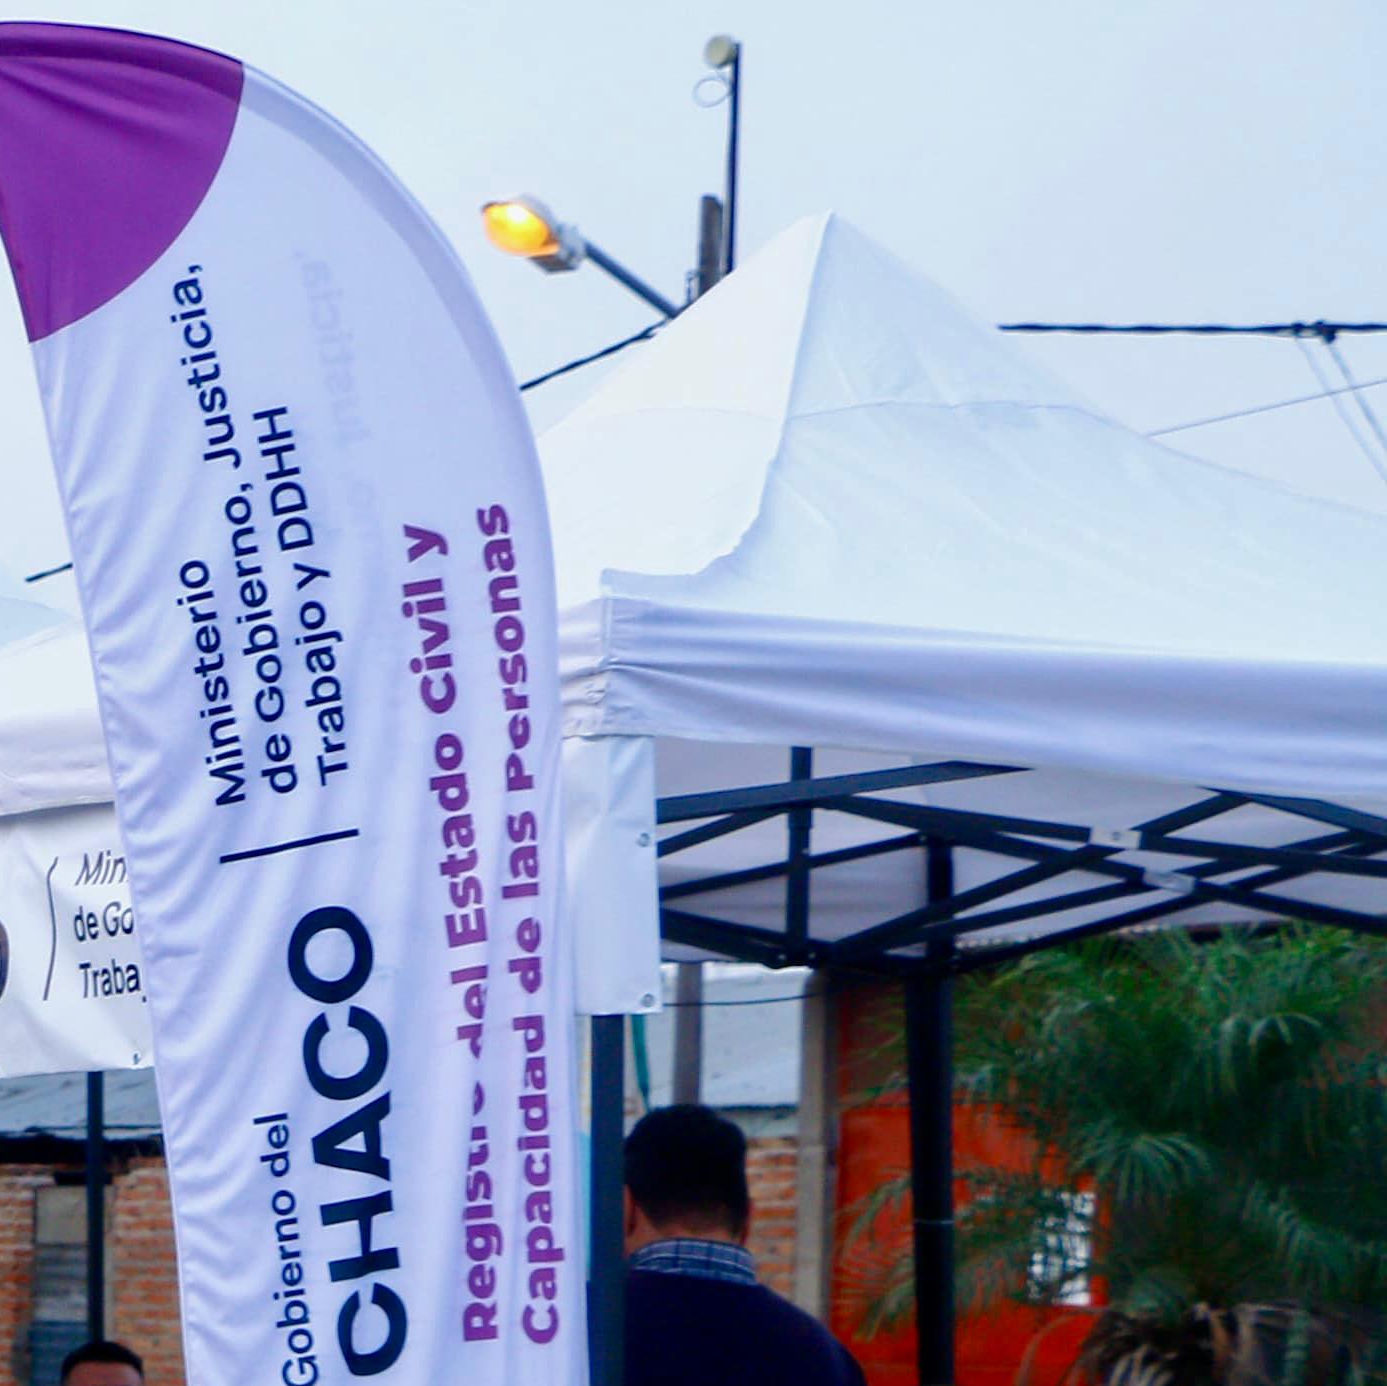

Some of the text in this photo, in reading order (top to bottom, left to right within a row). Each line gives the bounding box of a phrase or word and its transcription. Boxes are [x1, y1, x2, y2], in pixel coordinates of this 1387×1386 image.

[171, 264, 299, 793] de Gobierno, Justicia,
[253, 406, 349, 785] Trabajo y DDHH
[403, 523, 449, 562] y
[177, 558, 248, 807] Ministerio
[402, 577, 457, 715] Civil
[74, 905, 99, 942] de
[430, 731, 488, 948] Estado
[476, 503, 565, 1345] Capacidad de las Personas
[79, 958, 146, 1003] Traba
[252, 1112, 291, 1178] del
[286, 905, 409, 1377] CHACO
